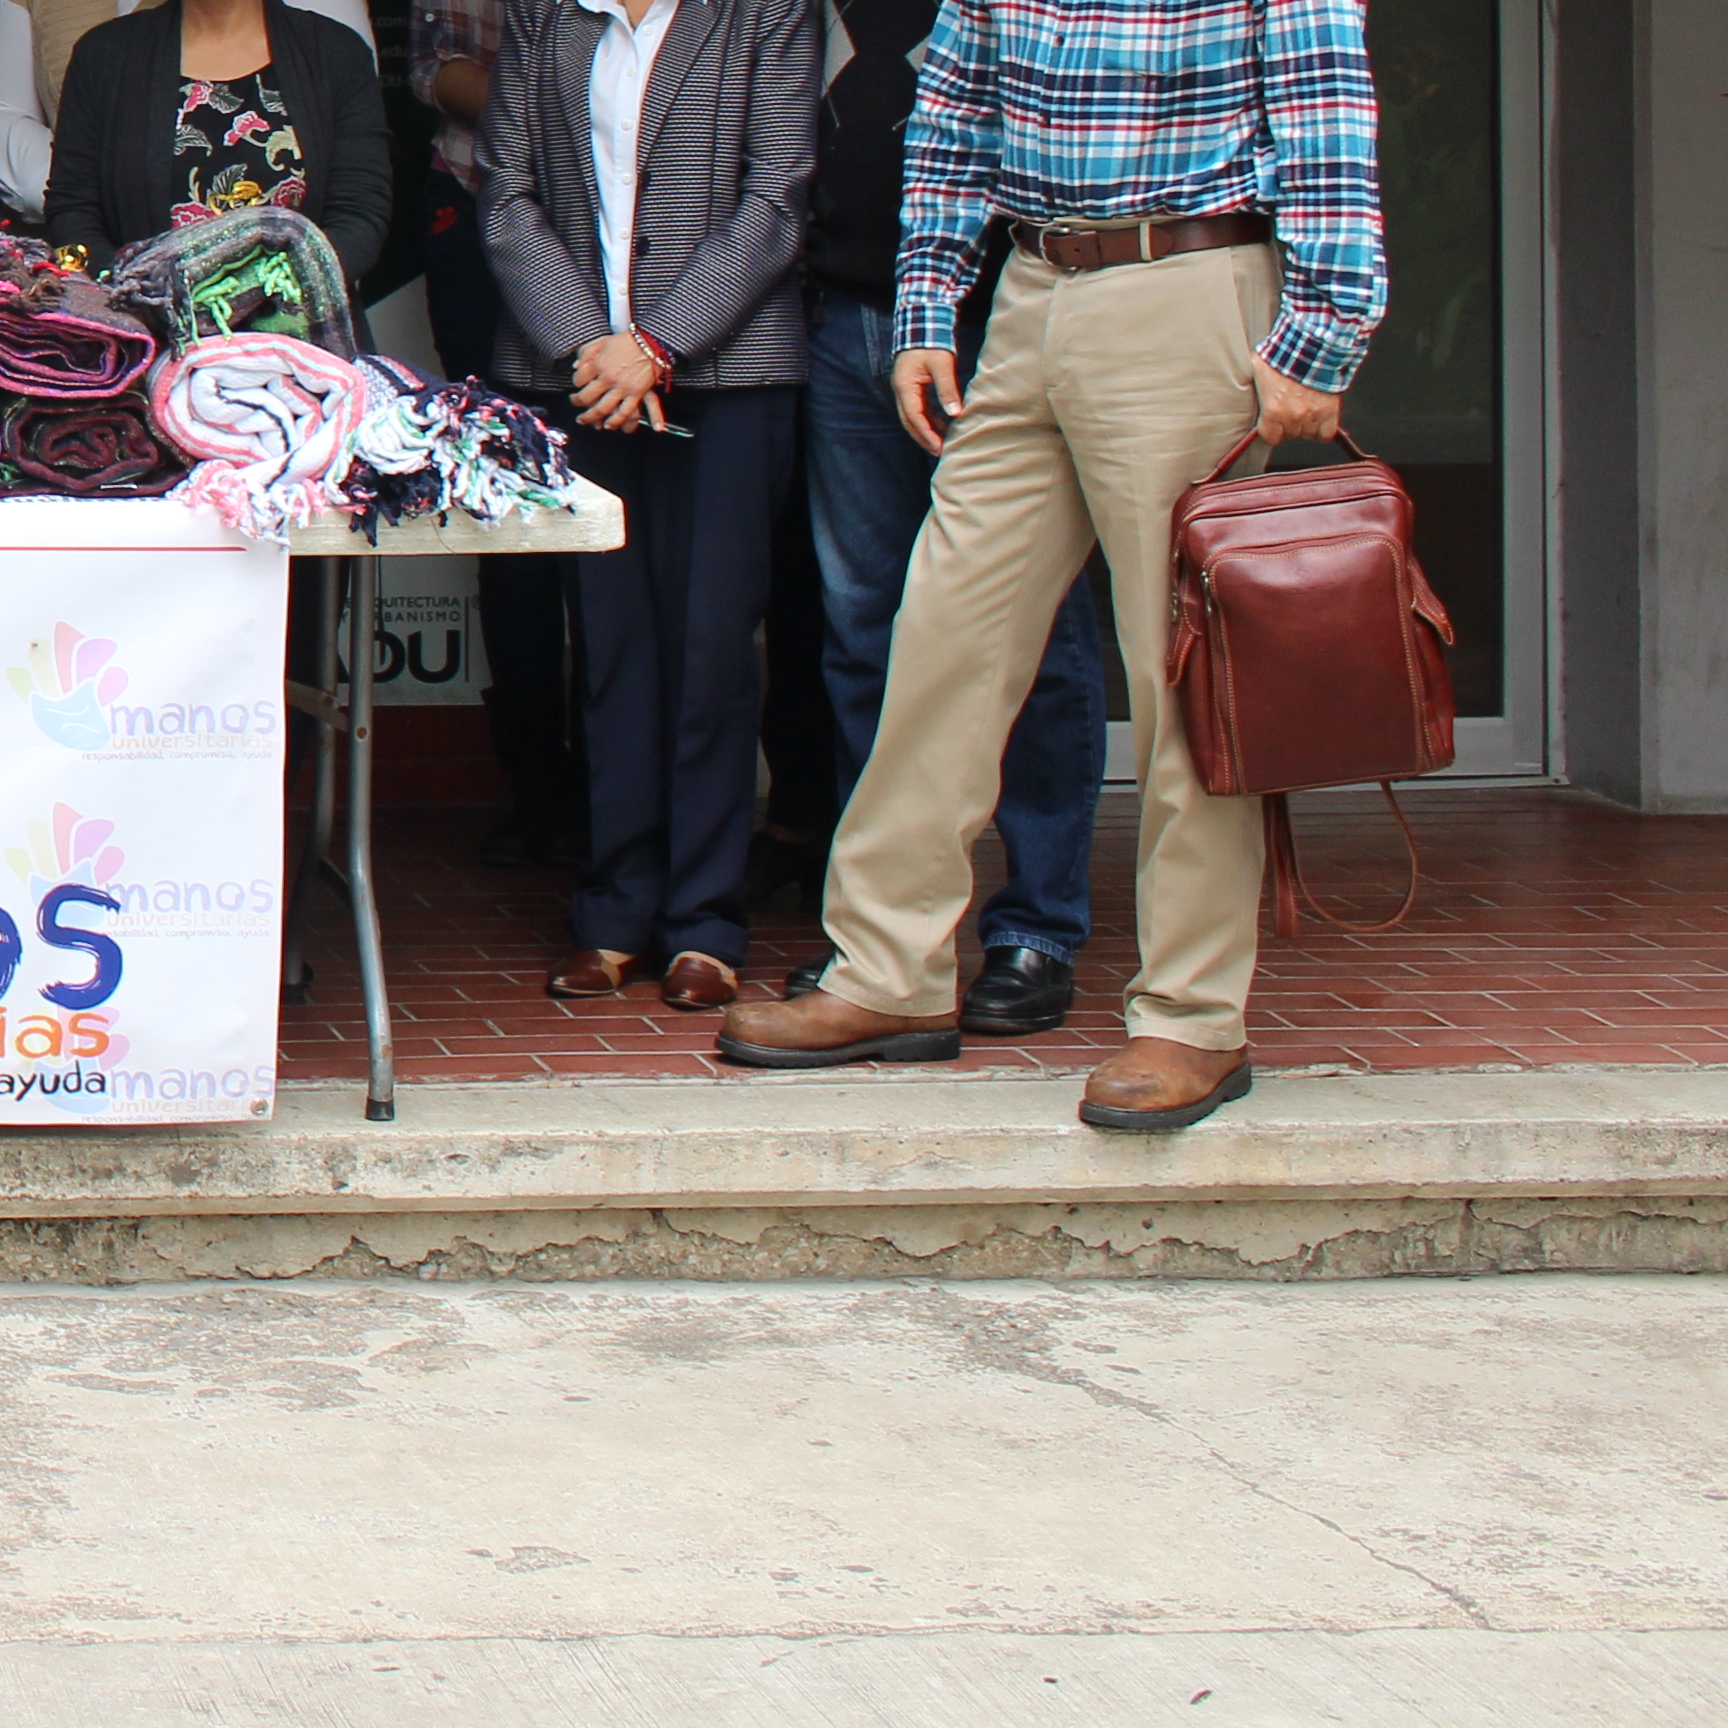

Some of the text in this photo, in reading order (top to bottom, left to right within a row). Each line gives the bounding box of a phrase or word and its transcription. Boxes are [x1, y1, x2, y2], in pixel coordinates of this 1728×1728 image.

[375, 595, 461, 609] UITECTURA
[375, 611, 461, 623] BANISMO
[109, 699, 277, 736] manos
[111, 730, 273, 750] universitarias
[105, 877, 275, 914] manos
[109, 1064, 276, 1101] manos
